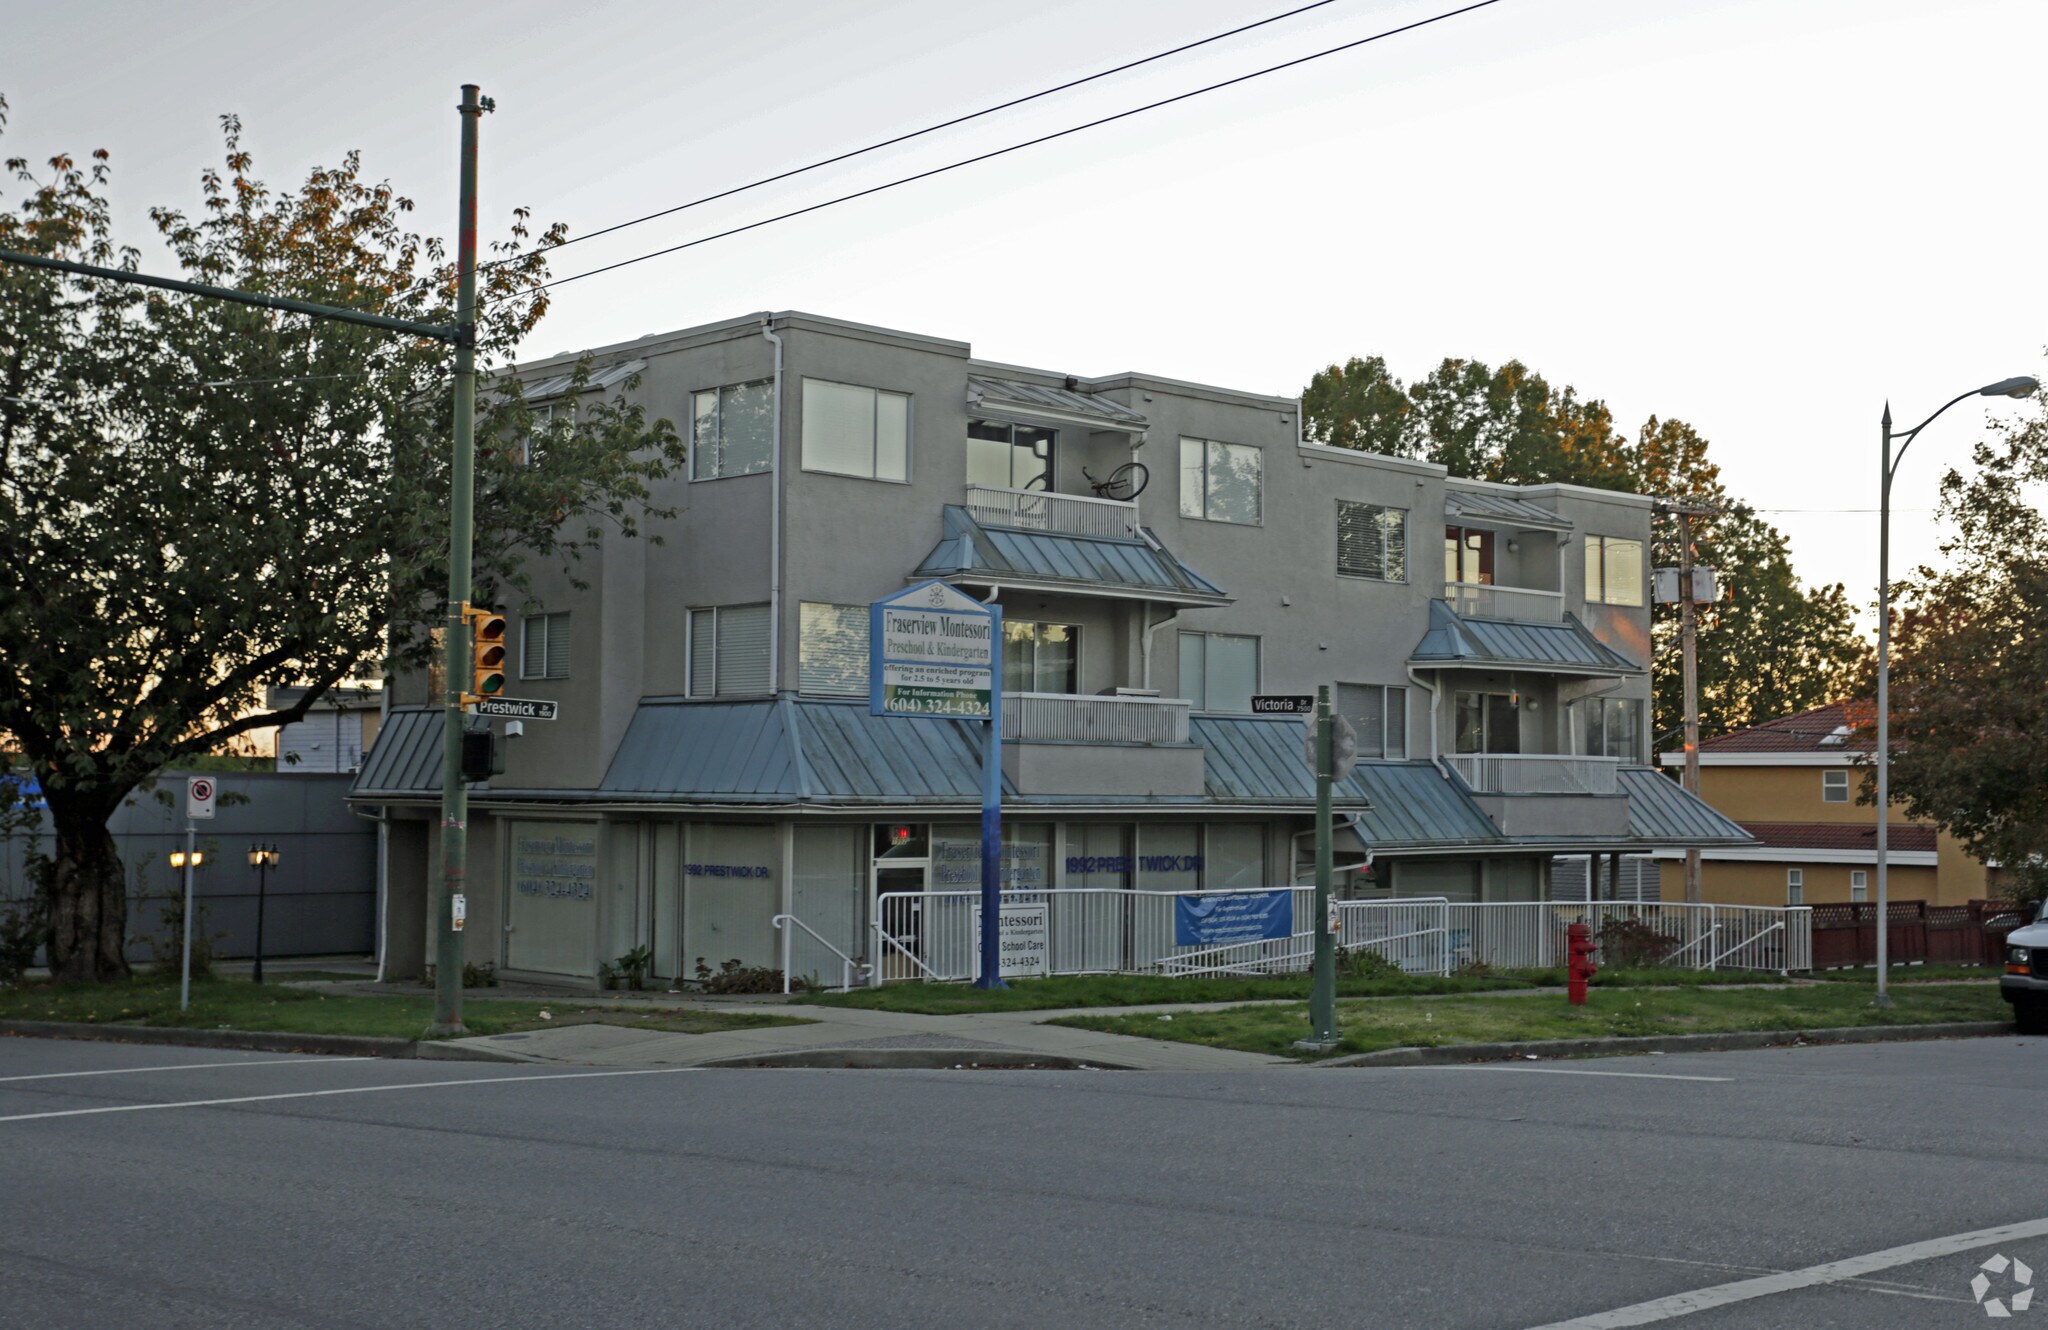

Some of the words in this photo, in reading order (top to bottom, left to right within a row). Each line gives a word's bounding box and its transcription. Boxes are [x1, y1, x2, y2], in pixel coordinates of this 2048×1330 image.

[885, 612, 937, 635] Fraserview
[940, 616, 991, 640] Montessori
[887, 638, 926, 655] Preschool
[927, 641, 934, 655] &
[937, 642, 989, 660] Kindergarten
[884, 664, 914, 674] offering
[926, 666, 958, 676] enriched
[959, 669, 990, 679] program
[901, 674, 912, 682] for
[914, 674, 925, 682] 2.5
[926, 675, 934, 683] to
[941, 677, 961, 685] years
[962, 677, 974, 685] old
[897, 687, 910, 696] For
[912, 688, 955, 698] Information
[956, 690, 978, 699] Phone
[480, 701, 535, 716] Prestwick
[884, 697, 922, 712] (604)
[925, 699, 990, 715] 324-4324
[1254, 698, 1294, 711] Victoria
[704, 865, 753, 877] PRESTWICK
[1065, 856, 1095, 874] 1992
[1002, 941, 1026, 951] School
[1027, 940, 1045, 951] Care
